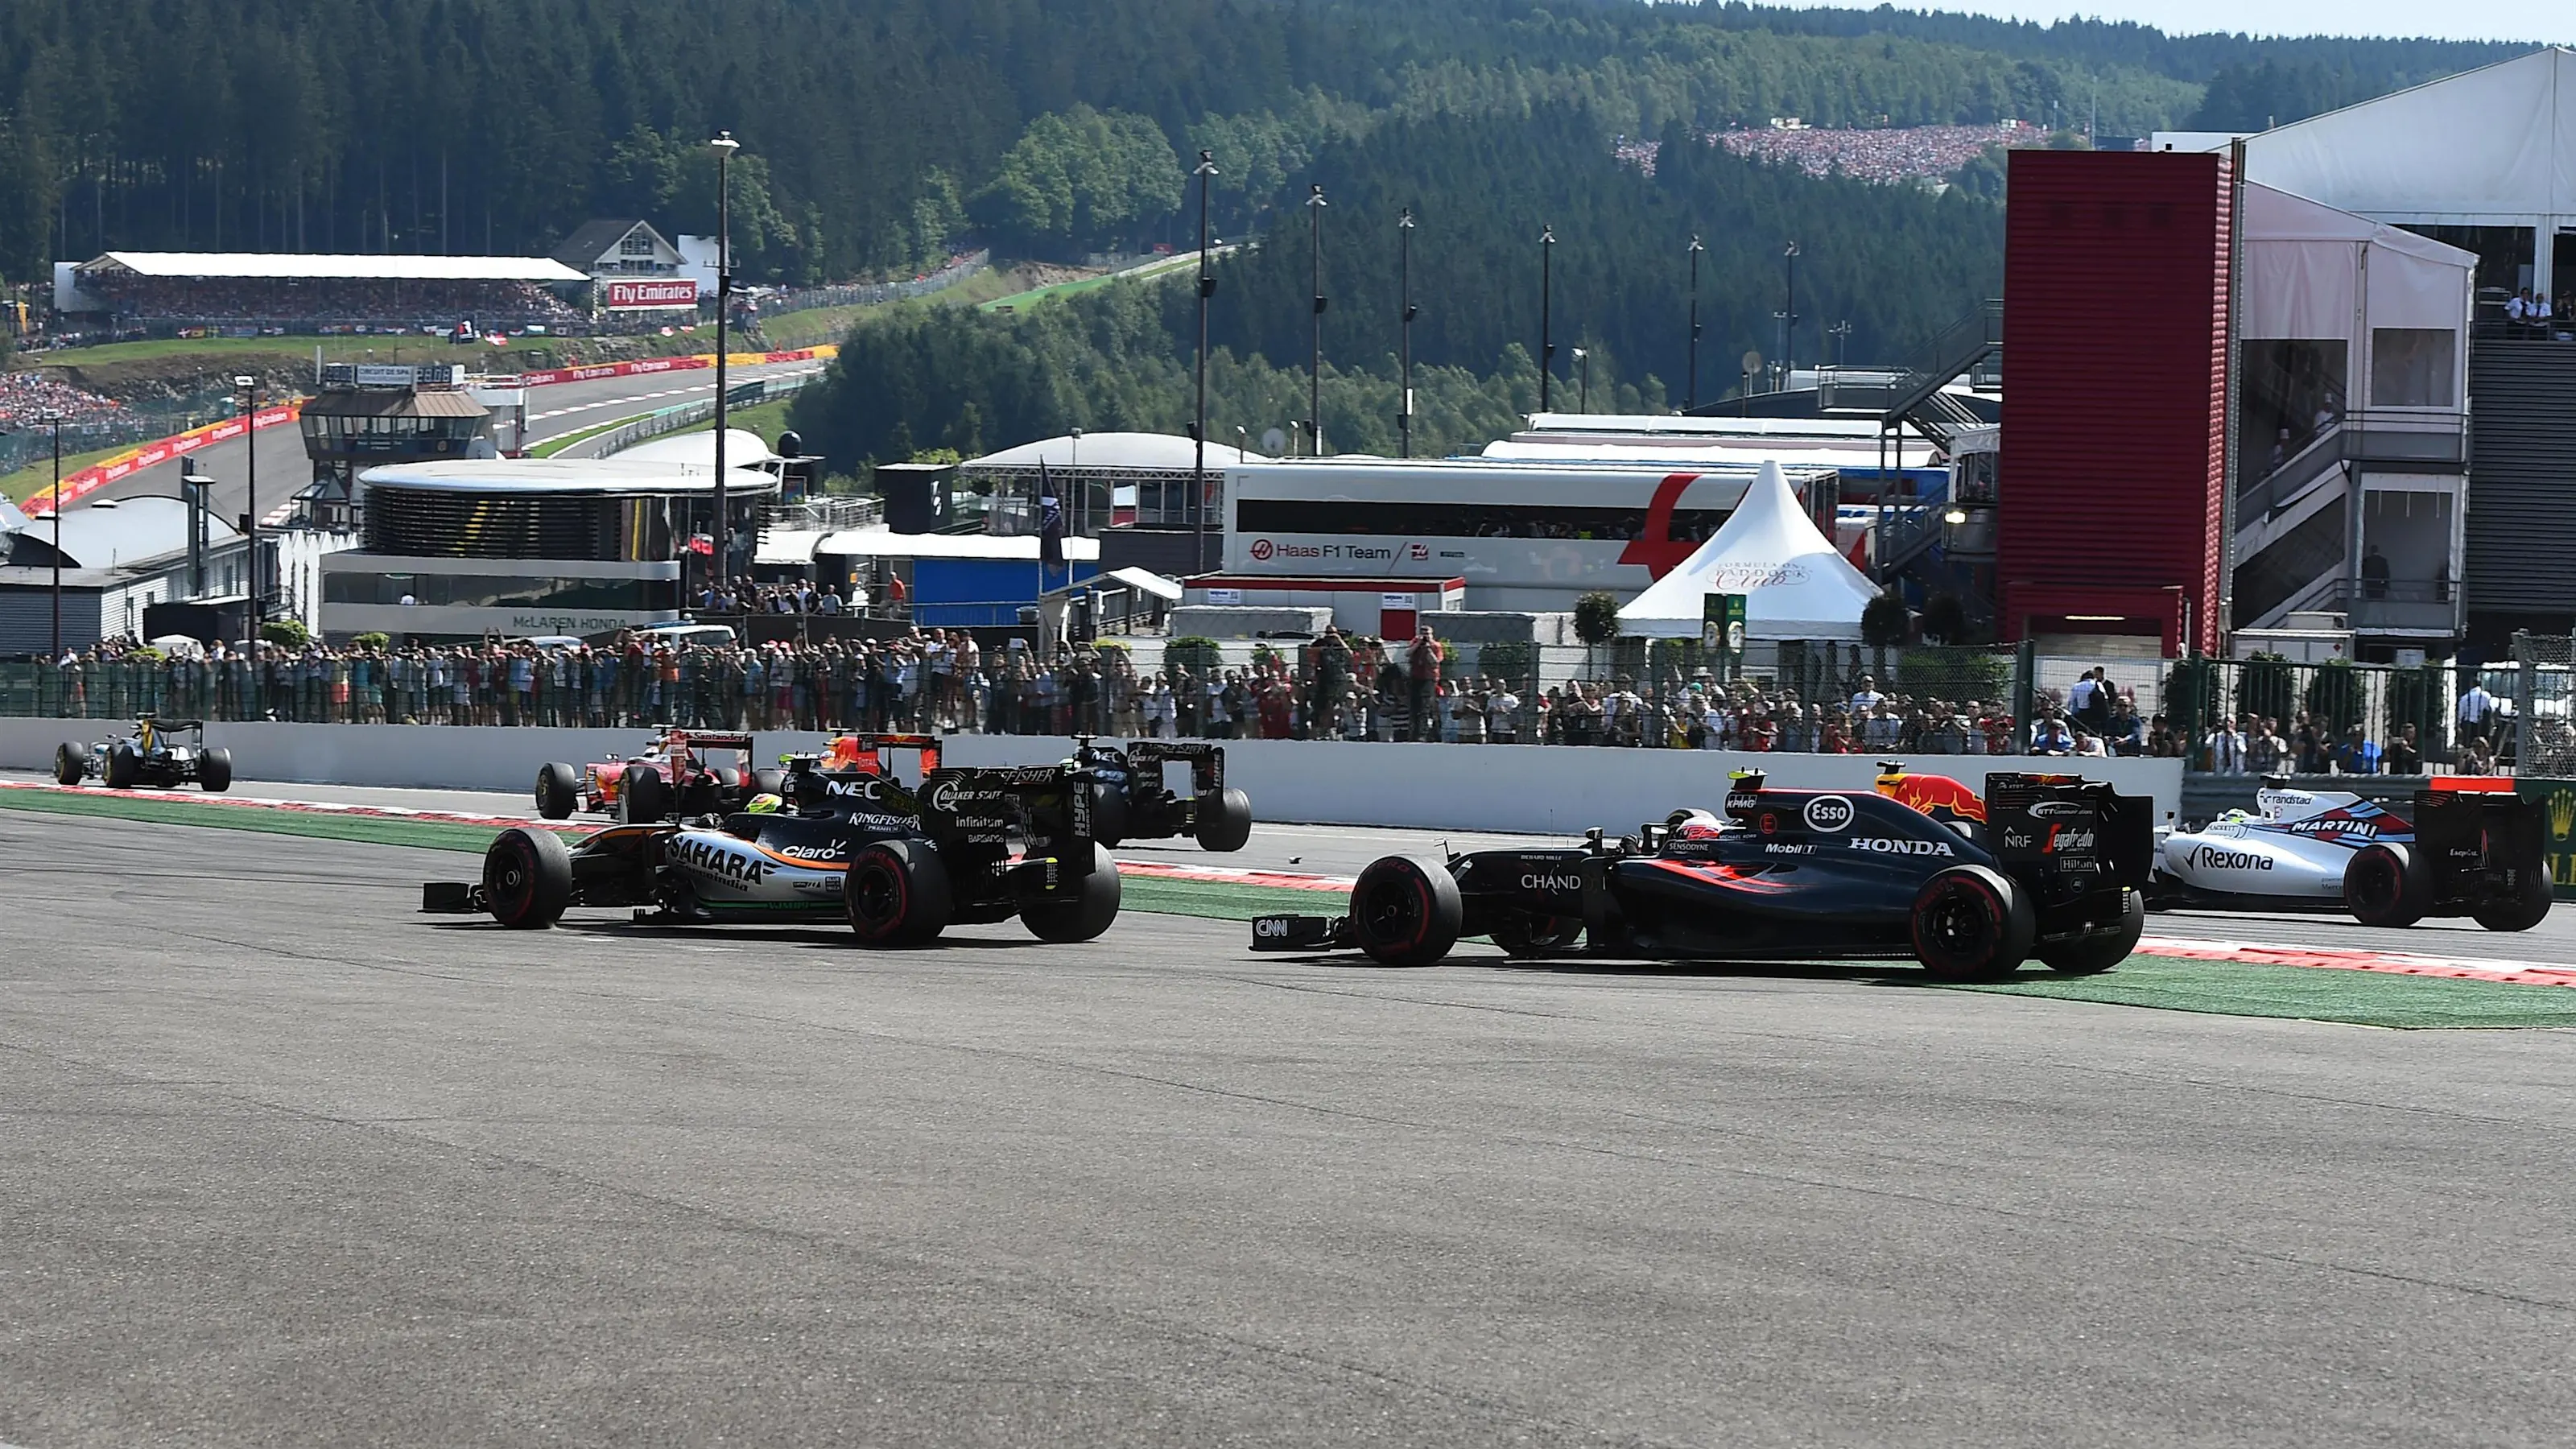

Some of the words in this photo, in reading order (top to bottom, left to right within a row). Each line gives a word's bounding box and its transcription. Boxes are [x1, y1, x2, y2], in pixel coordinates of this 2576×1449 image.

[614, 285, 635, 303] Fly
[638, 284, 692, 300] Emirates
[573, 370, 584, 379] Fly
[585, 368, 615, 378] Emirates
[1277, 544, 1319, 557] Haas
[1323, 545, 1340, 557] F1
[1345, 546, 1390, 559] Team
[1715, 571, 1786, 590] Club
[1716, 569, 1806, 578] PADDOCK
[513, 616, 576, 629] McLAREN
[580, 617, 626, 630] HONDA
[695, 732, 744, 741] Santander
[857, 757, 877, 767] TOTAL
[1090, 748, 1120, 763] NEC
[825, 780, 881, 799] NEC
[940, 790, 975, 801] QUAKER
[1727, 799, 1757, 808] KPMG
[2273, 795, 2313, 805] randstad
[1073, 781, 1086, 837] HYPE
[956, 815, 1004, 828] infinitum
[2291, 818, 2377, 837] MARTINI
[1669, 843, 1710, 852] SENSODYNE
[1847, 838, 1955, 857] HONDA
[2004, 835, 2033, 848] NRF
[1765, 844, 1802, 855] Mobil
[670, 835, 762, 886] SAHARA
[2062, 859, 2093, 869] Hilton
[2202, 847, 2273, 870] Rexona
[1521, 874, 1607, 890] CHAND
[1256, 919, 1288, 937] CNN
